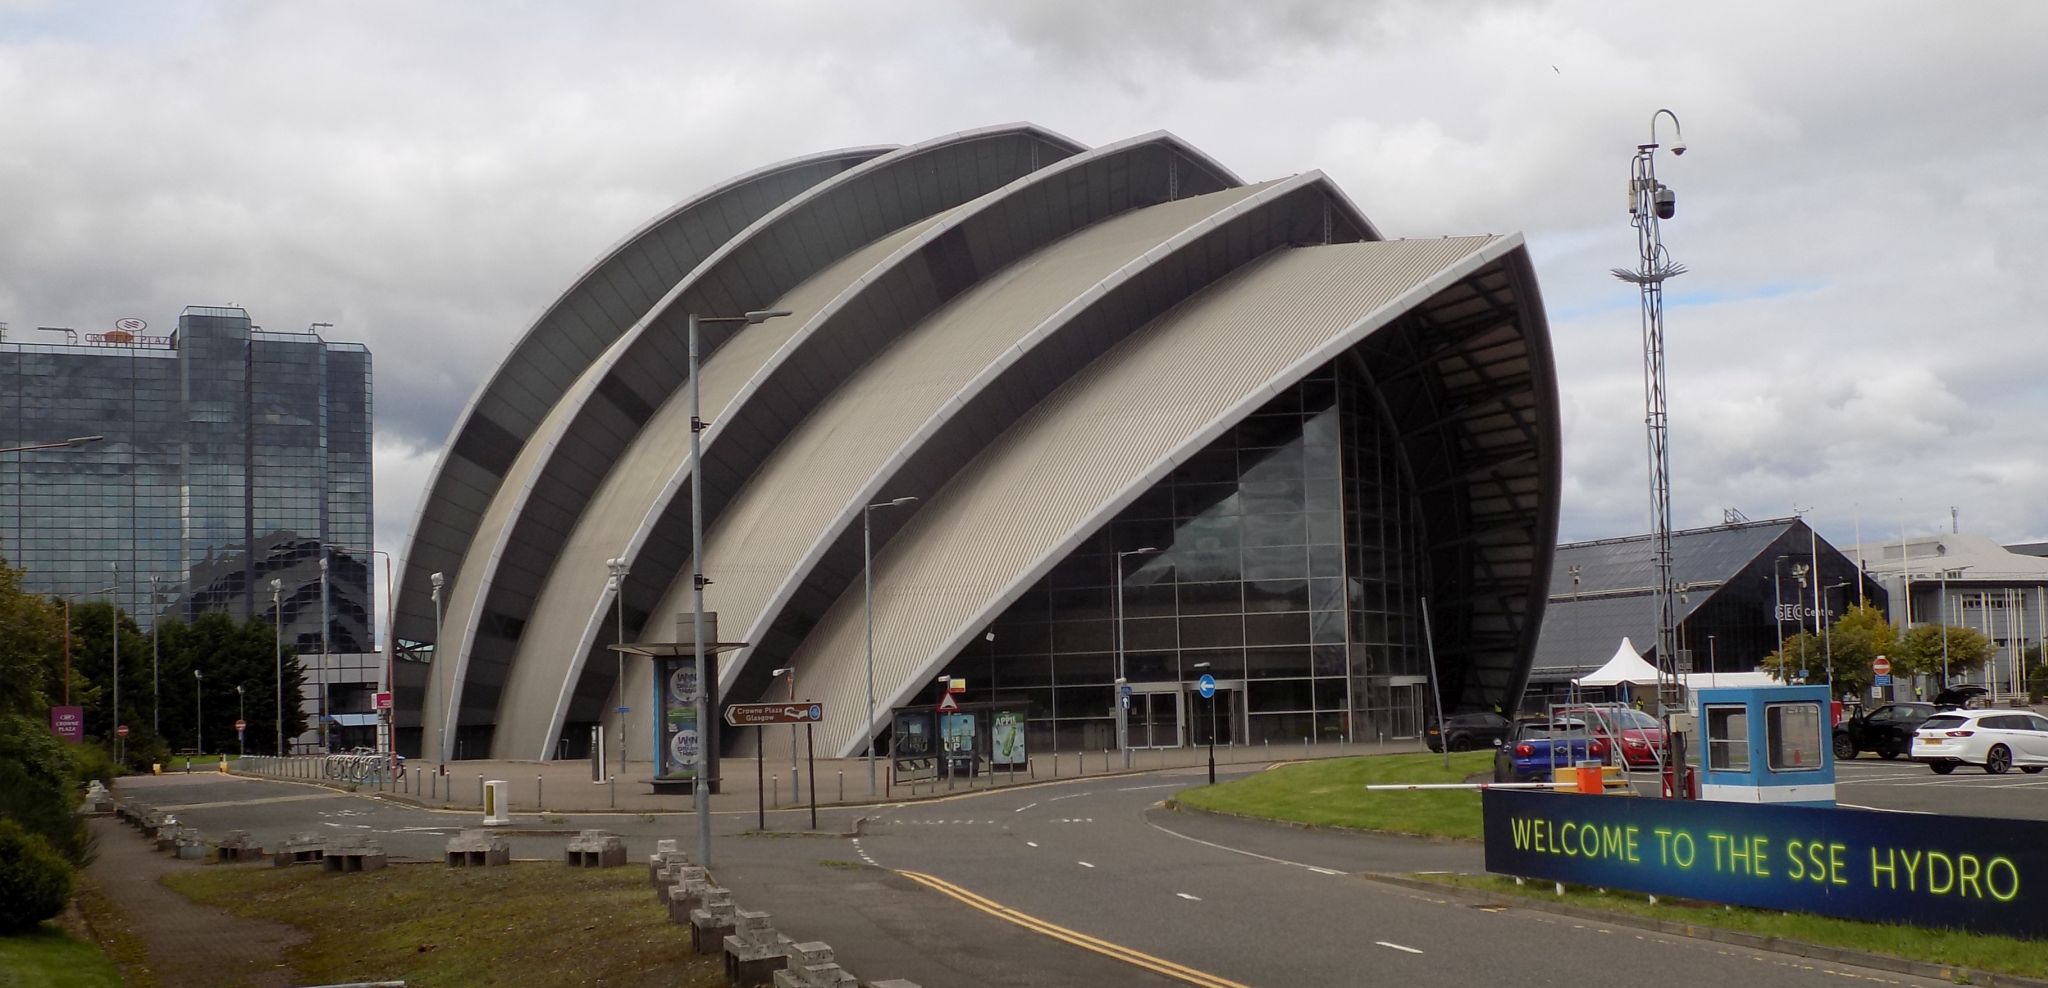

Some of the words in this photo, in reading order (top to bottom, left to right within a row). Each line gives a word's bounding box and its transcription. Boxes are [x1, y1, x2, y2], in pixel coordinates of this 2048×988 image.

[1775, 604, 1803, 621] SEC
[1804, 608, 1833, 617] Cente
[944, 742, 960, 752] UP
[1511, 817, 1640, 862] WELCOME
[1654, 829, 1696, 867] TO
[1708, 833, 1770, 876] THE
[1788, 841, 1848, 884] SSE
[1871, 846, 2019, 900] HYDRO
